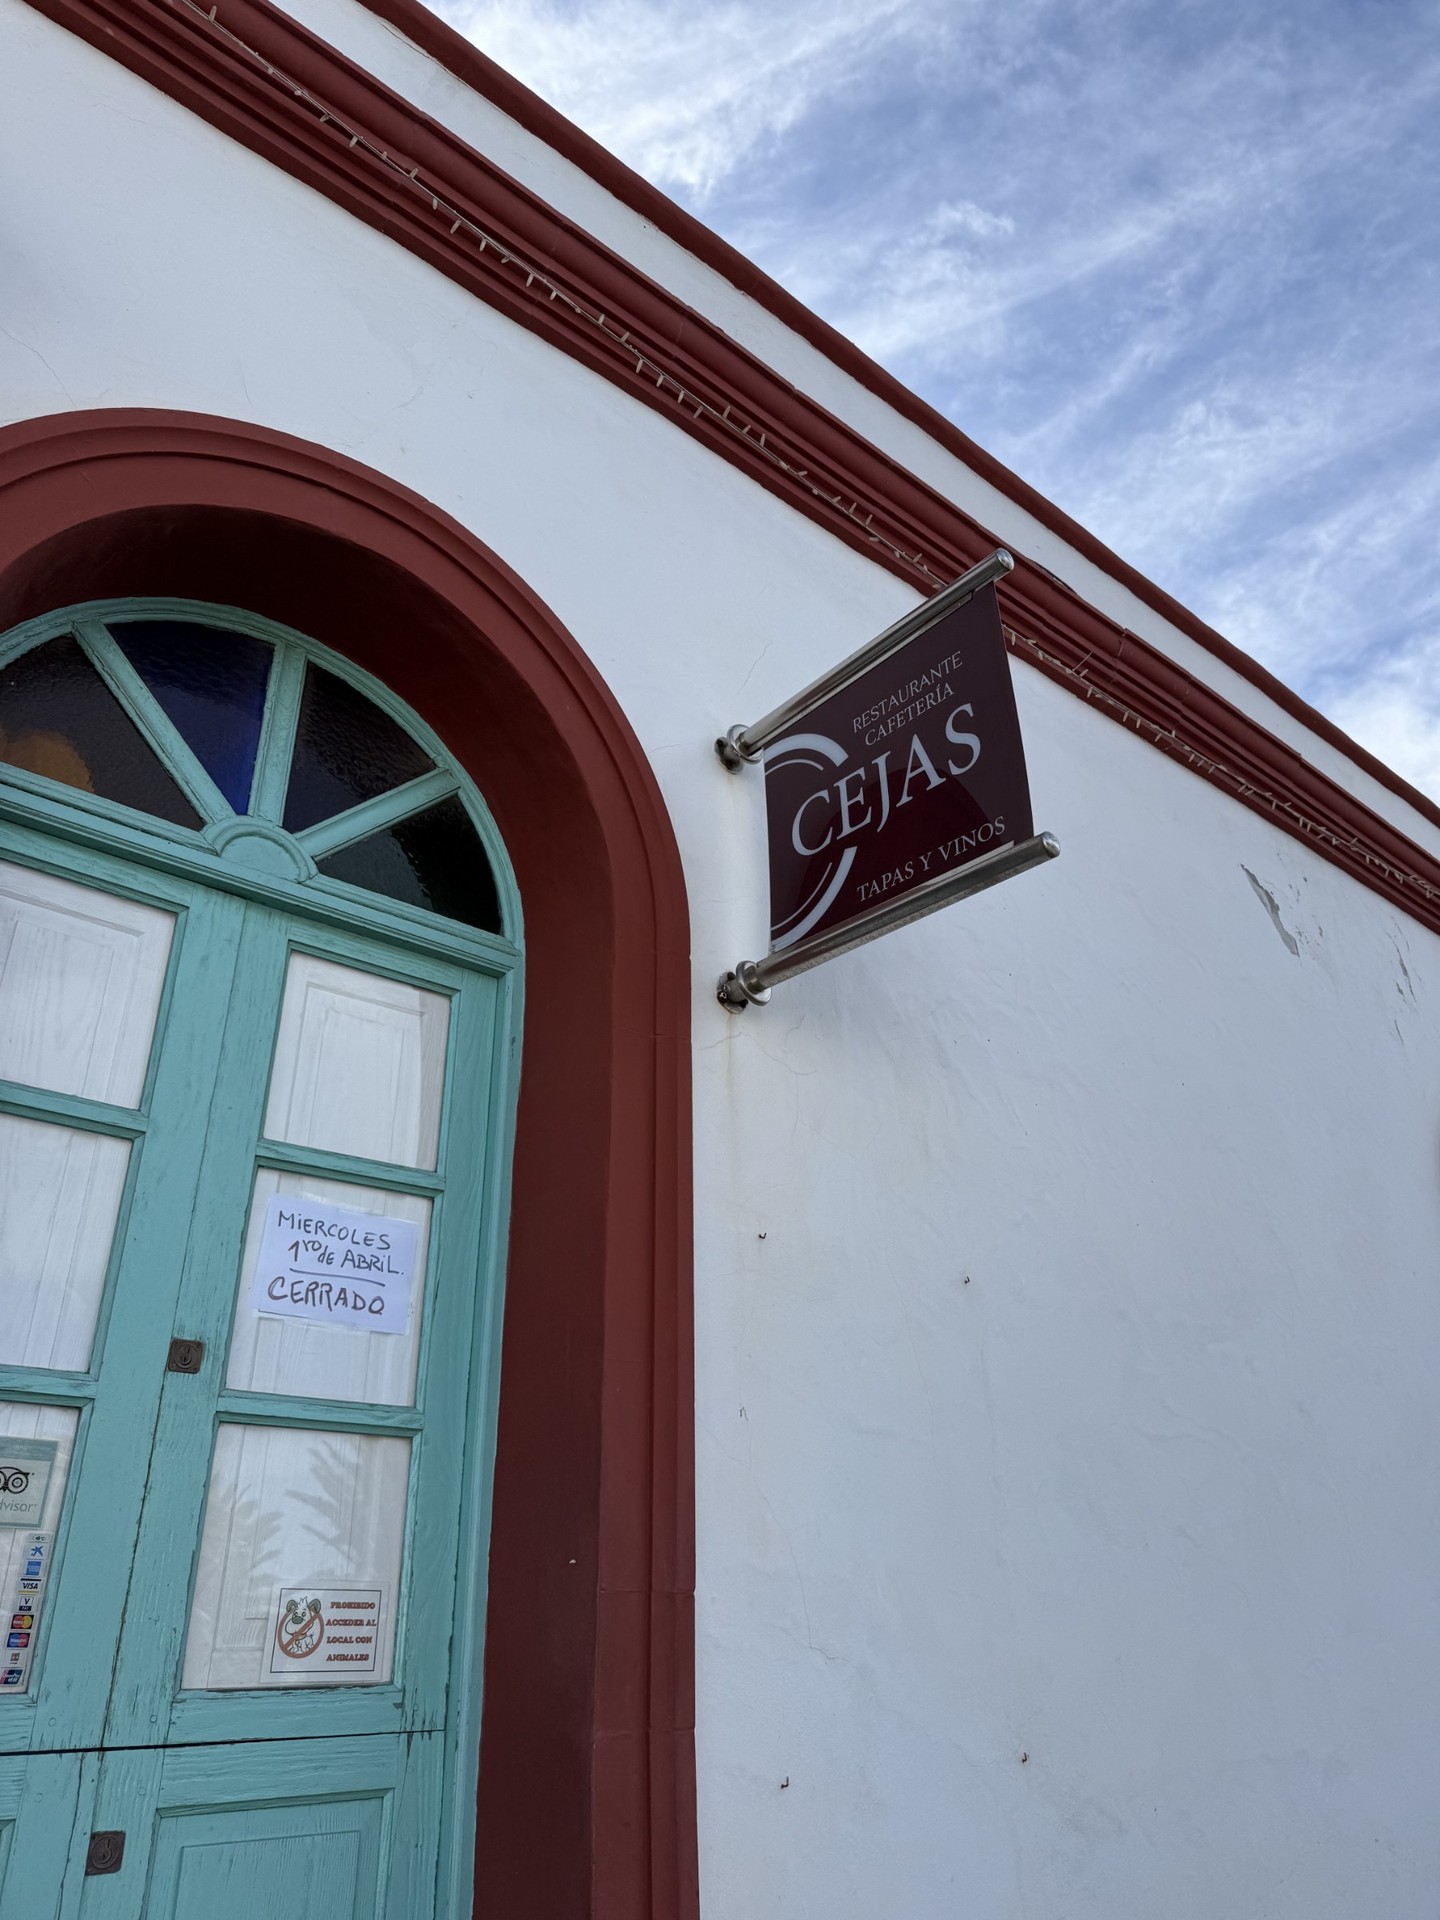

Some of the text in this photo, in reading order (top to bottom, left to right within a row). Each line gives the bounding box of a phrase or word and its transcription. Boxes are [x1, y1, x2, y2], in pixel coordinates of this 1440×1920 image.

[852, 650, 963, 734] RESTAURANTE
[864, 681, 955, 747] CAFETERÍA
[791, 703, 982, 857] CEJAS
[856, 815, 1006, 902] TAPAS Y VINOS
[267, 1276, 386, 1316] CERRADO
[22, 1582, 39, 1590] VISA
[330, 1601, 376, 1610] PROHIBIDO
[325, 1618, 377, 1627] ACCEDER AL
[326, 1635, 373, 1644] LOCAL CON
[326, 1653, 370, 1662] ANIMALES
